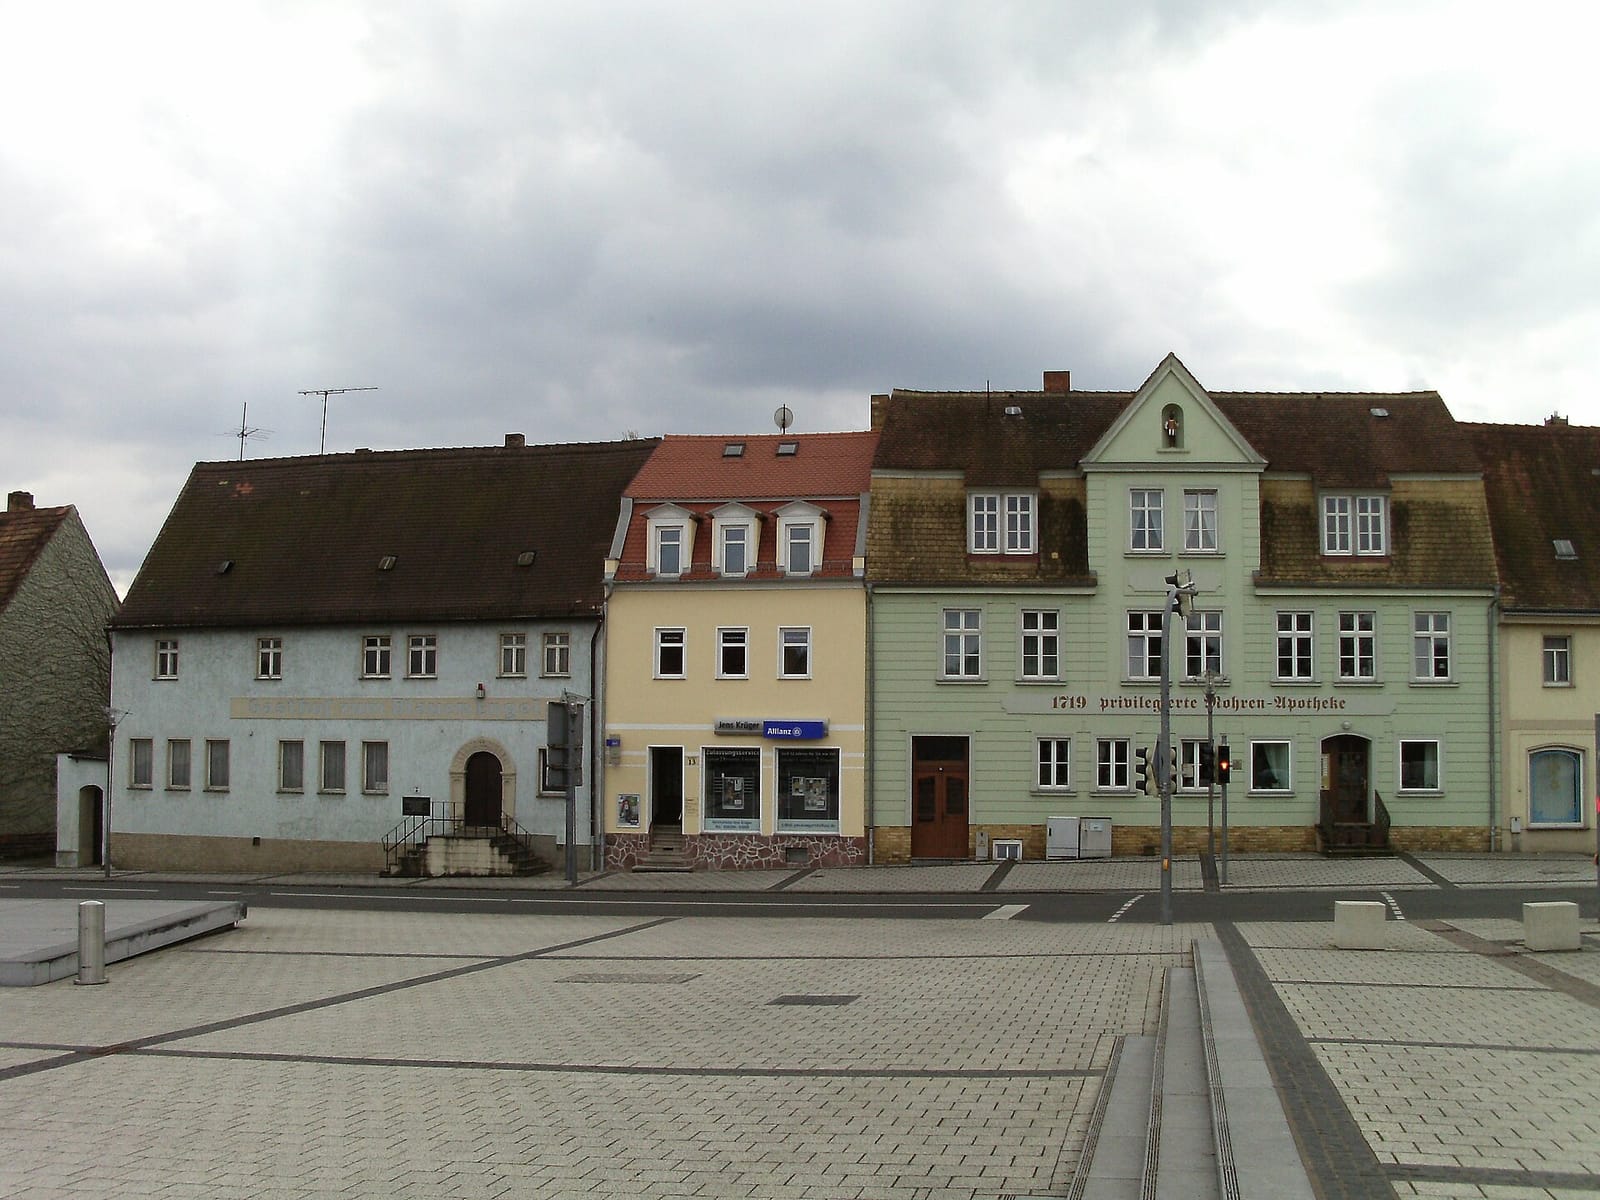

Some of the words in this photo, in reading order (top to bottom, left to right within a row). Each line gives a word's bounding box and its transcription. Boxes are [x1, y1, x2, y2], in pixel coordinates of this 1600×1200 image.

[1052, 695, 1087, 709] 1719
[1100, 695, 1198, 713] privilegerte
[719, 721, 734, 730] Jens
[736, 721, 760, 732] Krüger
[767, 727, 792, 736] Allianz
